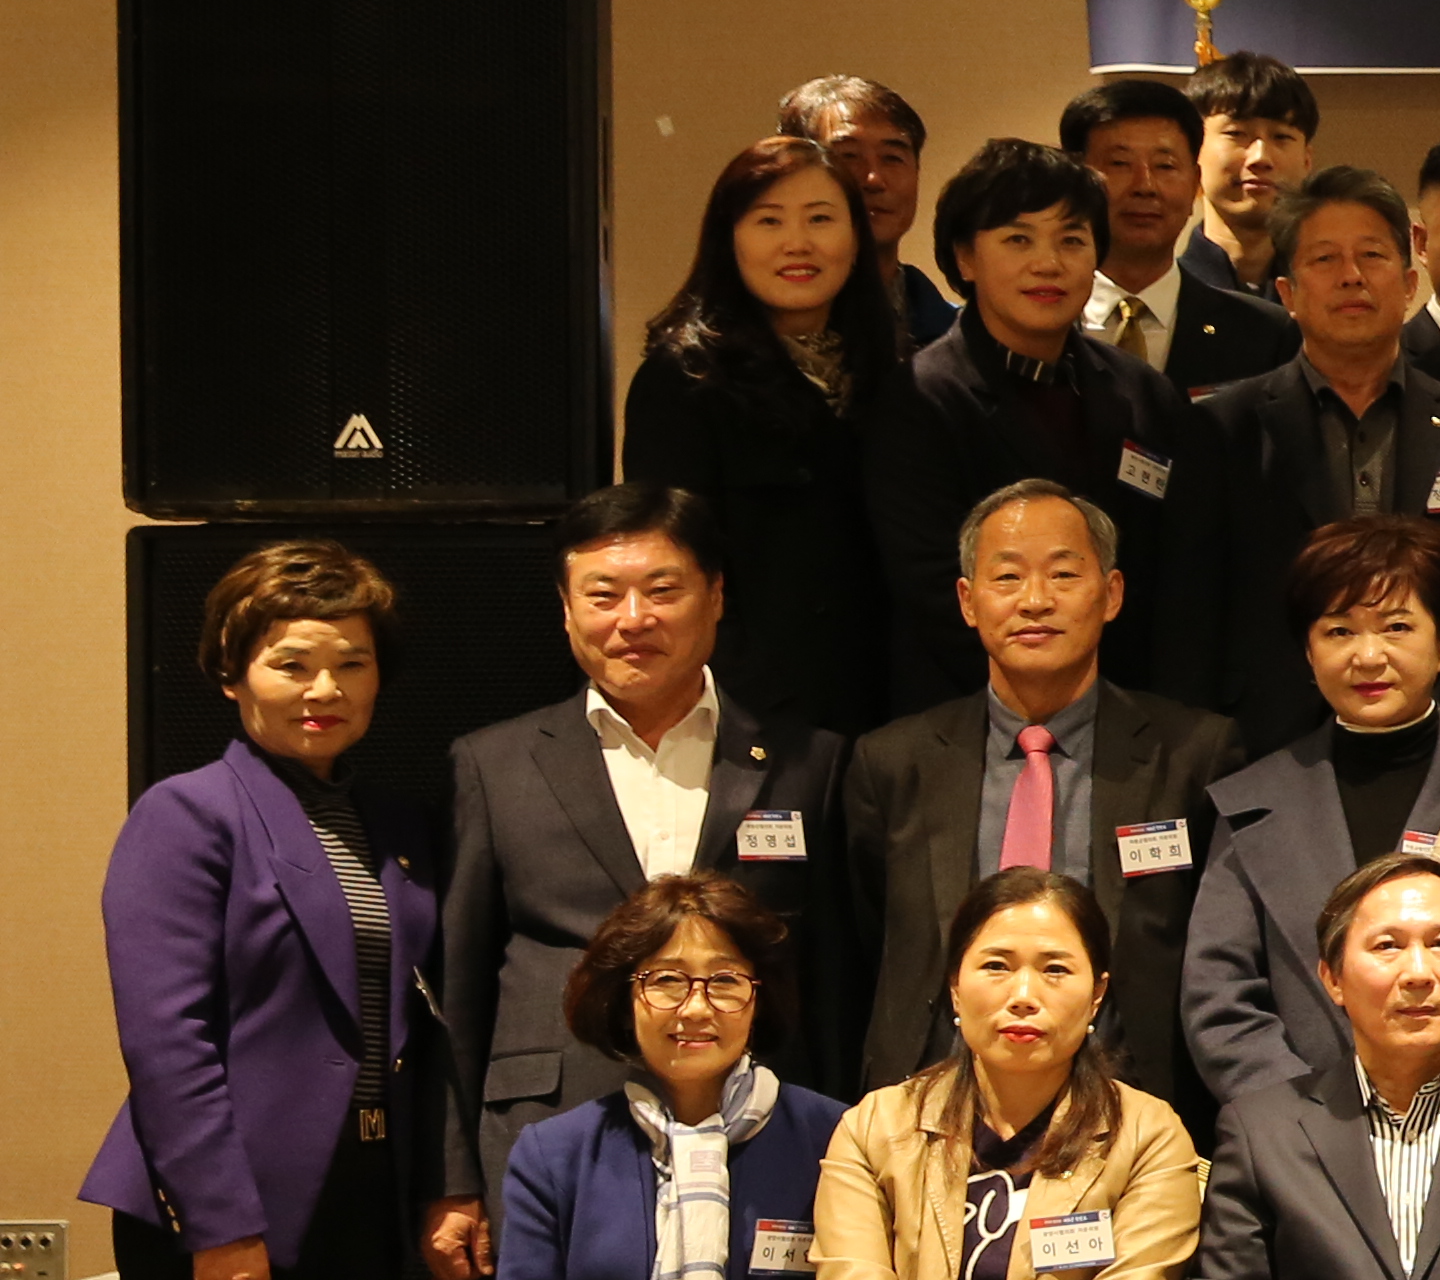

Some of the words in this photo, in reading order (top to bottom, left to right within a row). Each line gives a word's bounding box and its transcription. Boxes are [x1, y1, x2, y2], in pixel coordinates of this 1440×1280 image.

[745, 833, 797, 849] 정영섭
[1129, 843, 1183, 863] 이학희
[1042, 1237, 1103, 1257] 이선아
